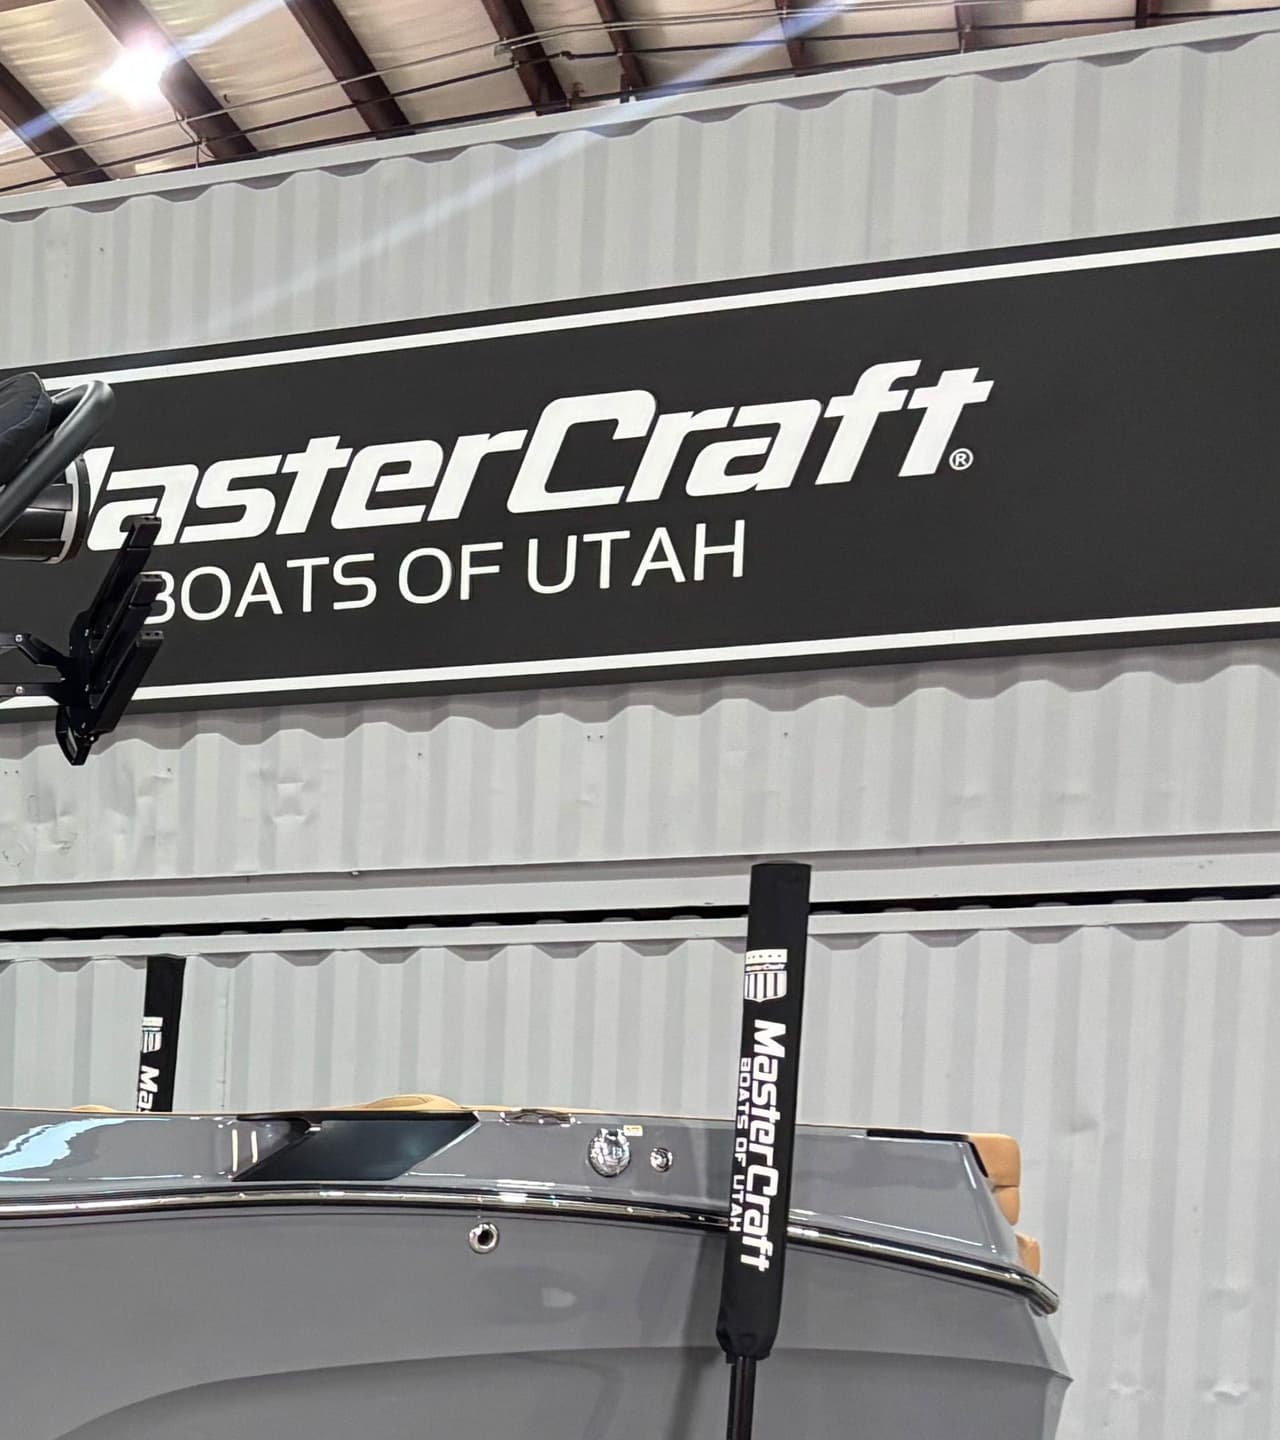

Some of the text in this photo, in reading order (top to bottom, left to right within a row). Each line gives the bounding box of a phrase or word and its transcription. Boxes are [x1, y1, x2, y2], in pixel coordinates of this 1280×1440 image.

[80, 361, 994, 552] asterCraft®
[399, 541, 504, 604] OF
[527, 519, 746, 594] UTAH
[729, 1057, 752, 1232] BOATS OF UTAH
[740, 1019, 787, 1272] MasterCraft
